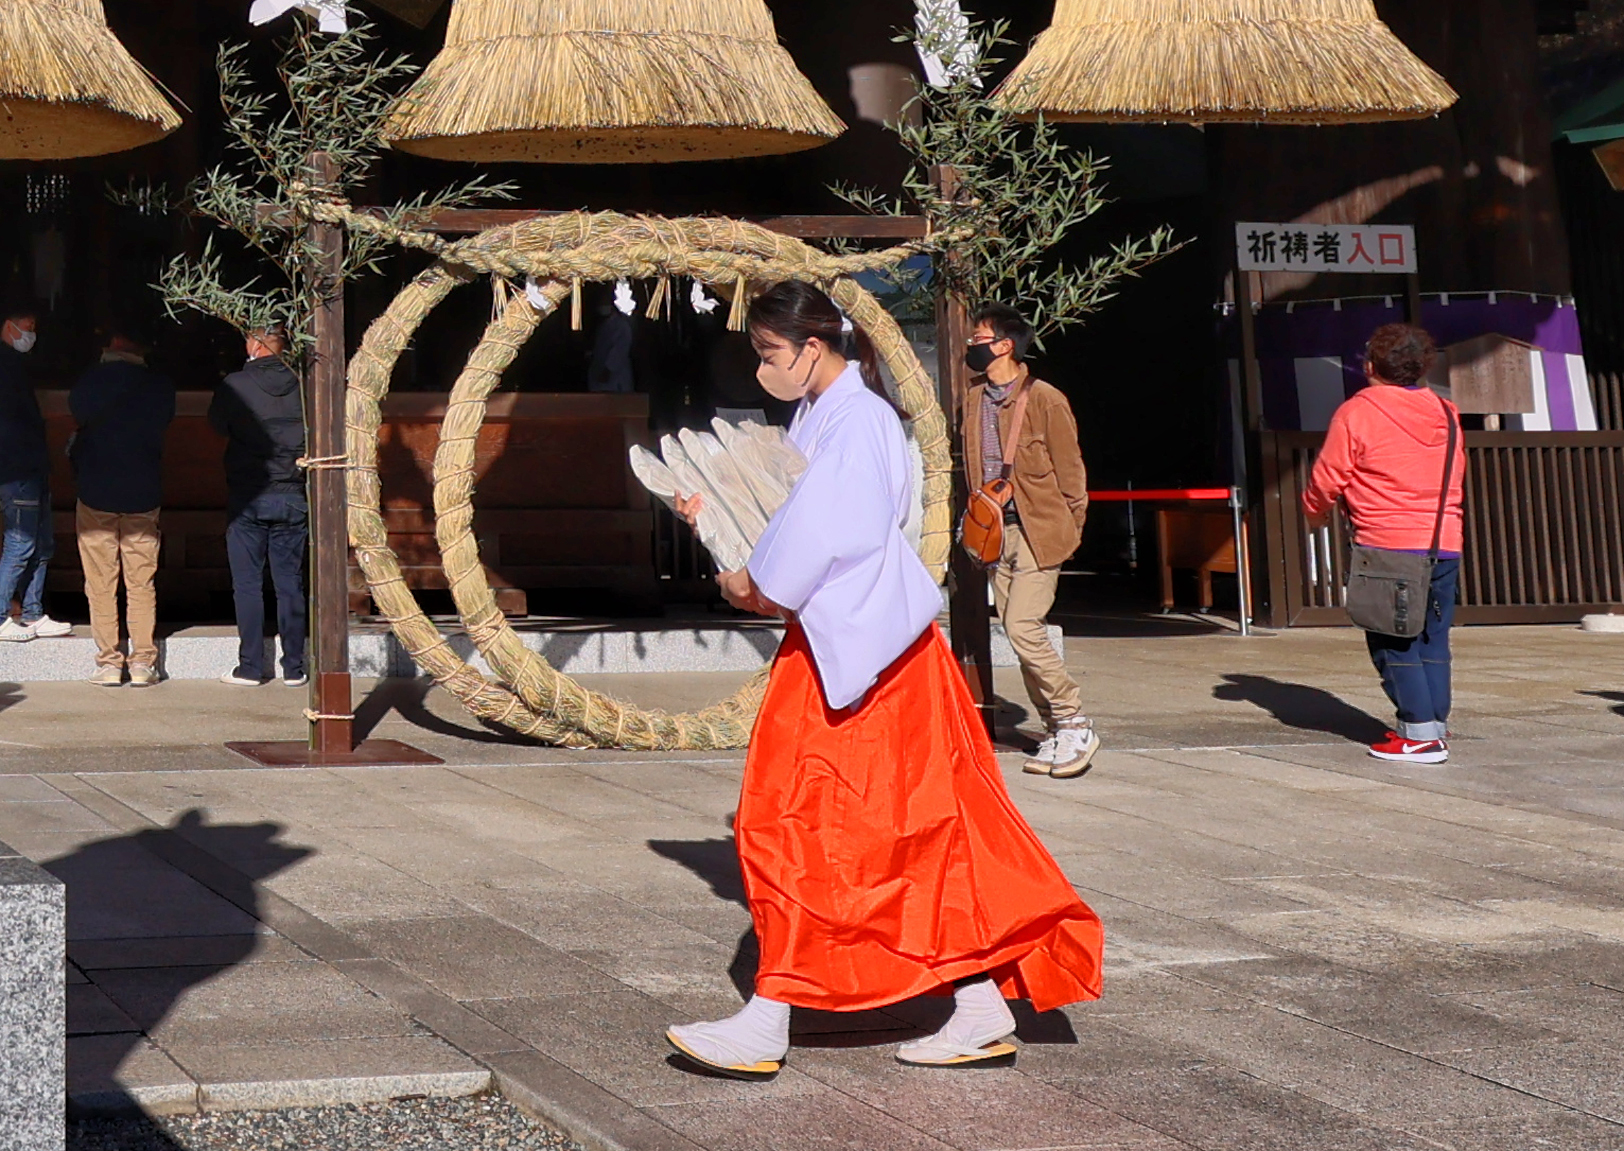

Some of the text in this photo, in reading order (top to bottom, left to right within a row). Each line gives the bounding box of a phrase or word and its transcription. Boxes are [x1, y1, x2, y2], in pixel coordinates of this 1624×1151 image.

[1247, 230, 1405, 265] 祈祷者入口
